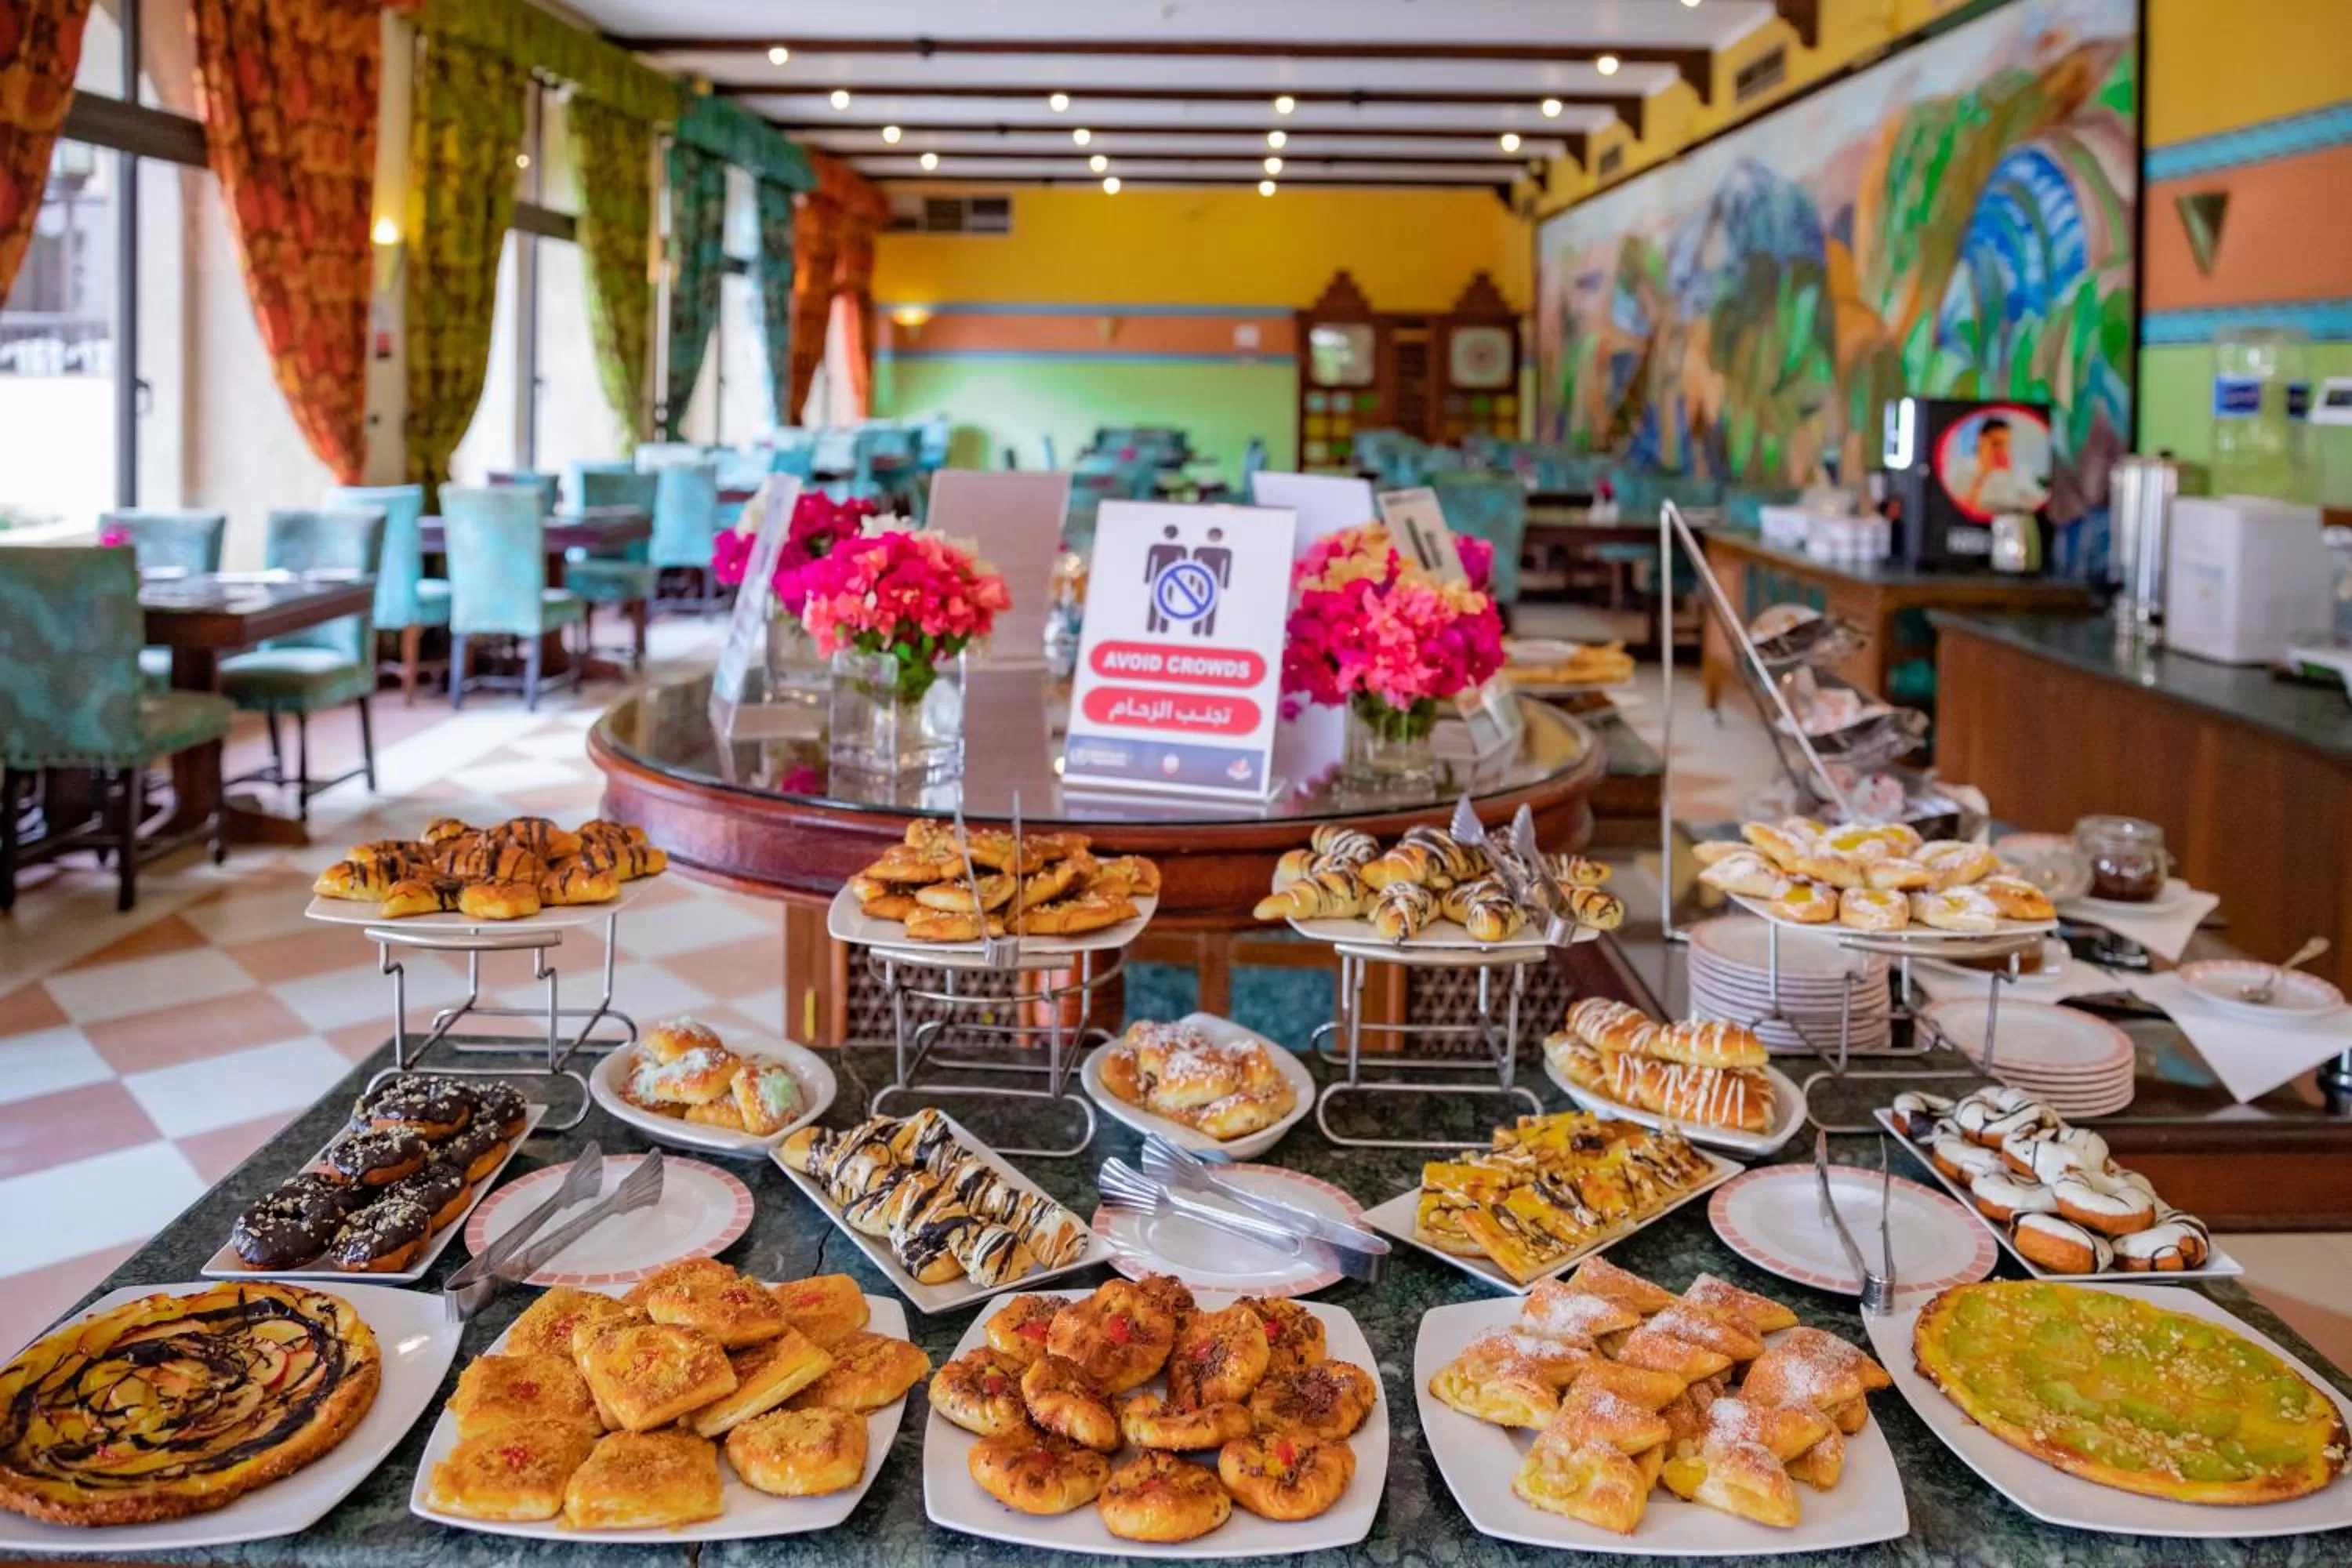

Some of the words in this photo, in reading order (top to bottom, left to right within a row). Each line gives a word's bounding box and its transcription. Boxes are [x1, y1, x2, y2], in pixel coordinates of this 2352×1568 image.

[1102, 651, 1162, 672] AVOID
[1167, 655, 1251, 679] CROWDS
[1107, 697, 1173, 721] الزحام
